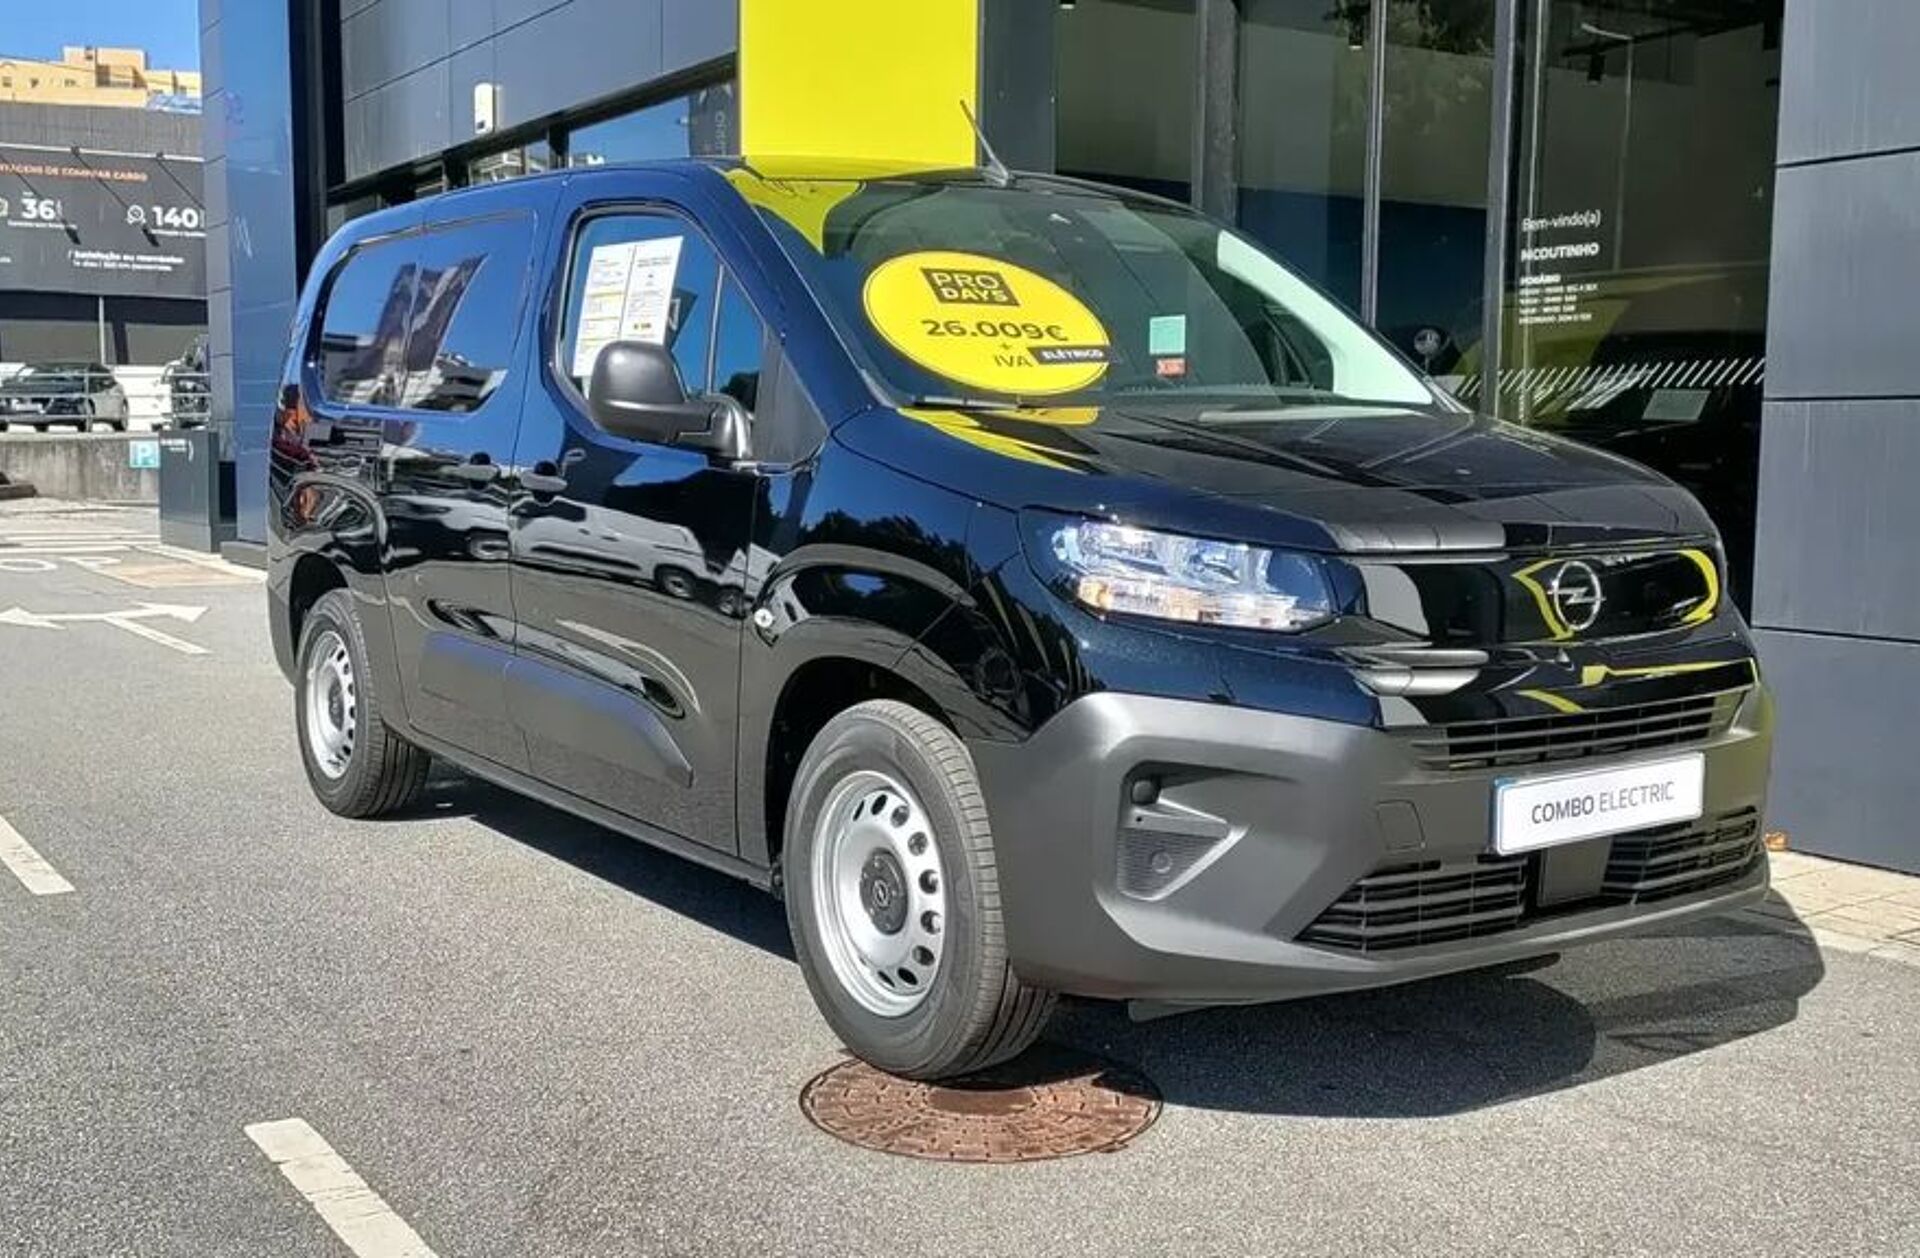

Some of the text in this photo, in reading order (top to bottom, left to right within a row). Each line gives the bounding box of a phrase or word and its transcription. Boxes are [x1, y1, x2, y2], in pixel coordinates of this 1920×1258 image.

[21, 198, 56, 220] 36
[152, 206, 199, 229] 140
[931, 272, 999, 289] PRO
[940, 286, 1009, 302] DAYS
[921, 319, 1069, 342] 26.009€
[994, 354, 1034, 368] IVA
[1531, 780, 1675, 824] COMBO ELECTRIC
